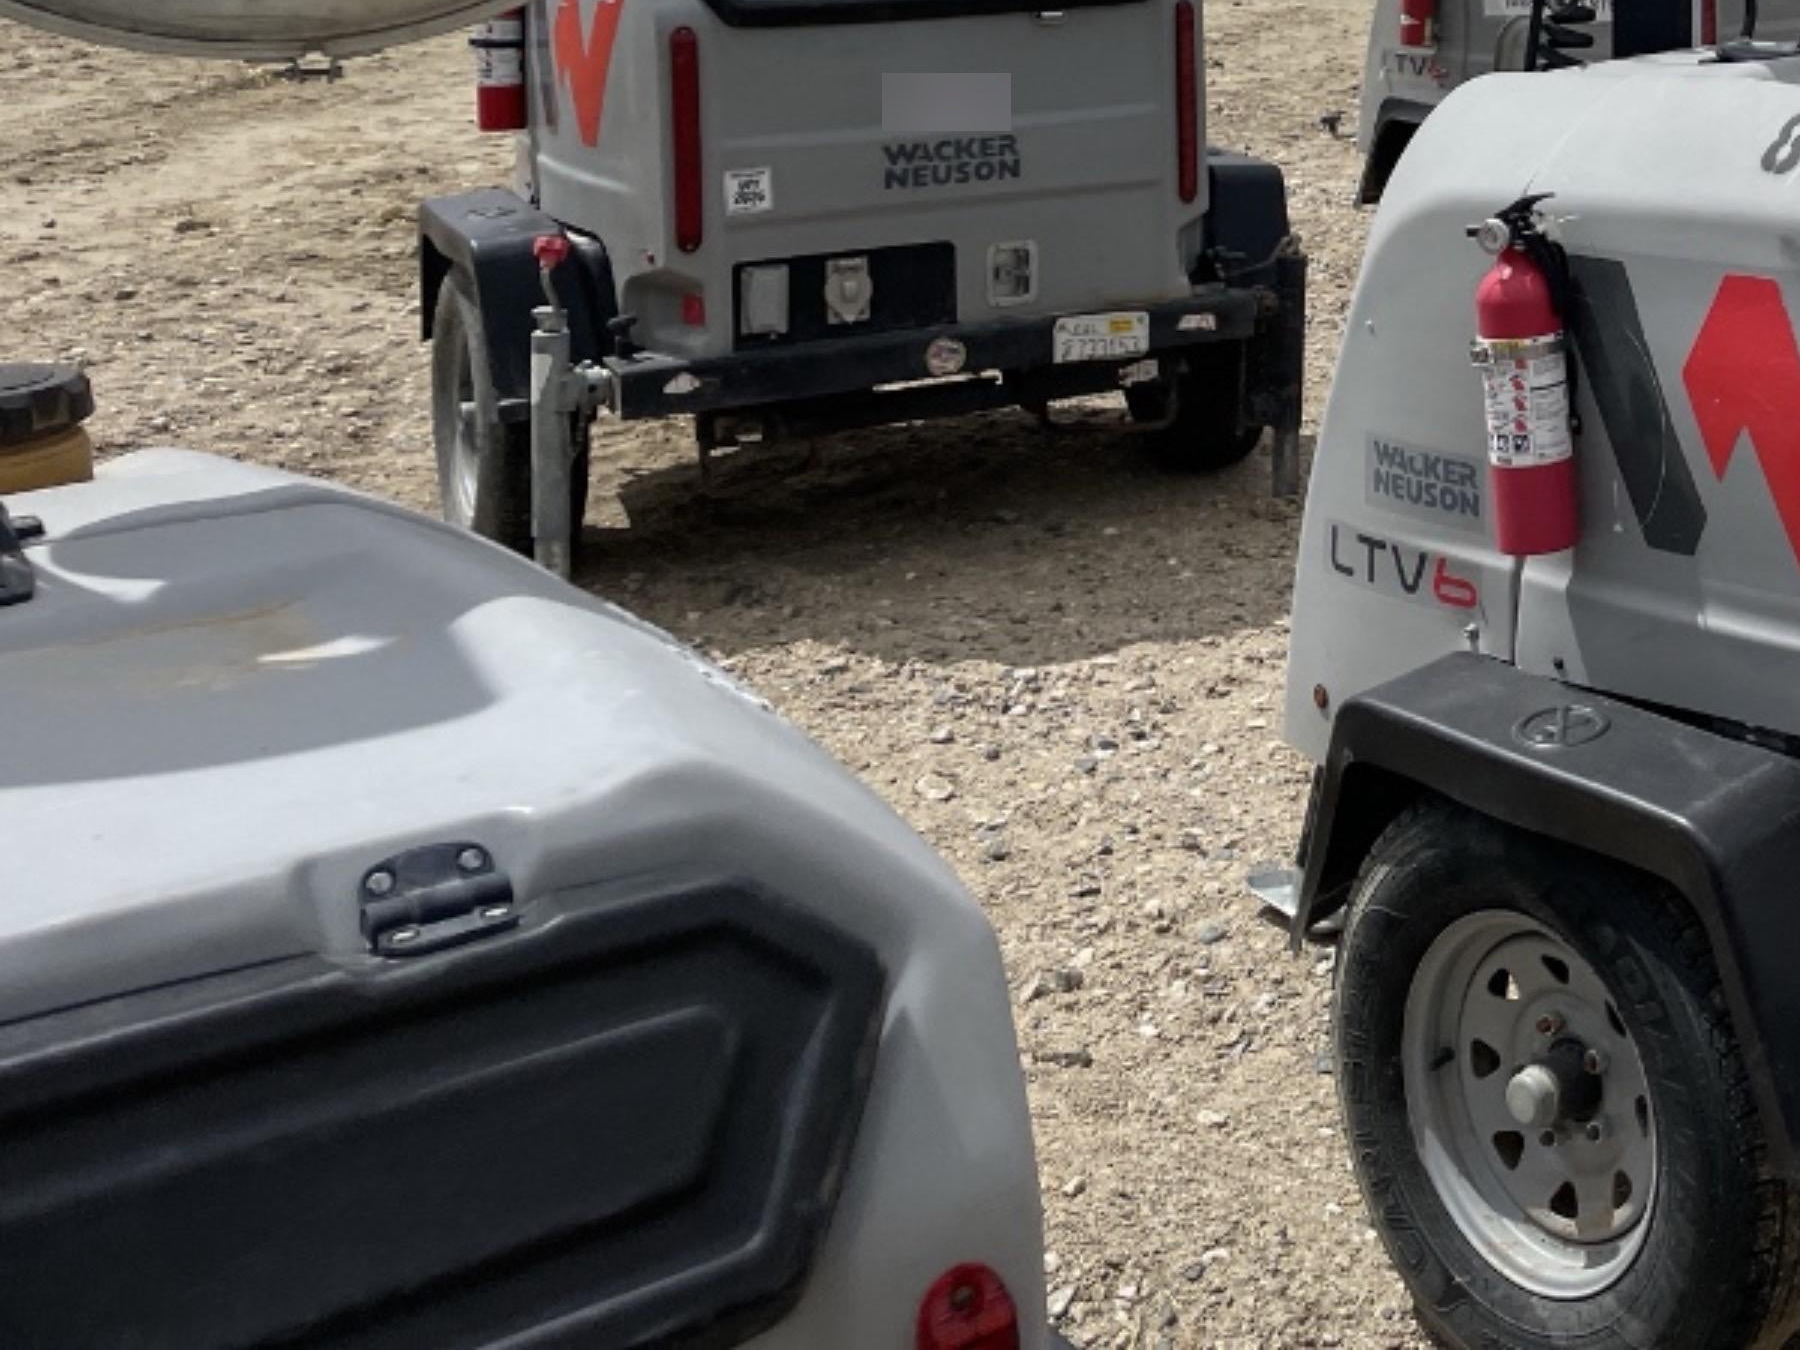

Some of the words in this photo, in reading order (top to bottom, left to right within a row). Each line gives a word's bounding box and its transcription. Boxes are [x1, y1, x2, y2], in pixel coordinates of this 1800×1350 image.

[882, 134, 1021, 166] WACKER
[884, 158, 1021, 190] NEUSON
[1373, 438, 1479, 491] WACKER
[1373, 467, 1481, 518] NEUSON
[1331, 524, 1478, 610] LTV6
